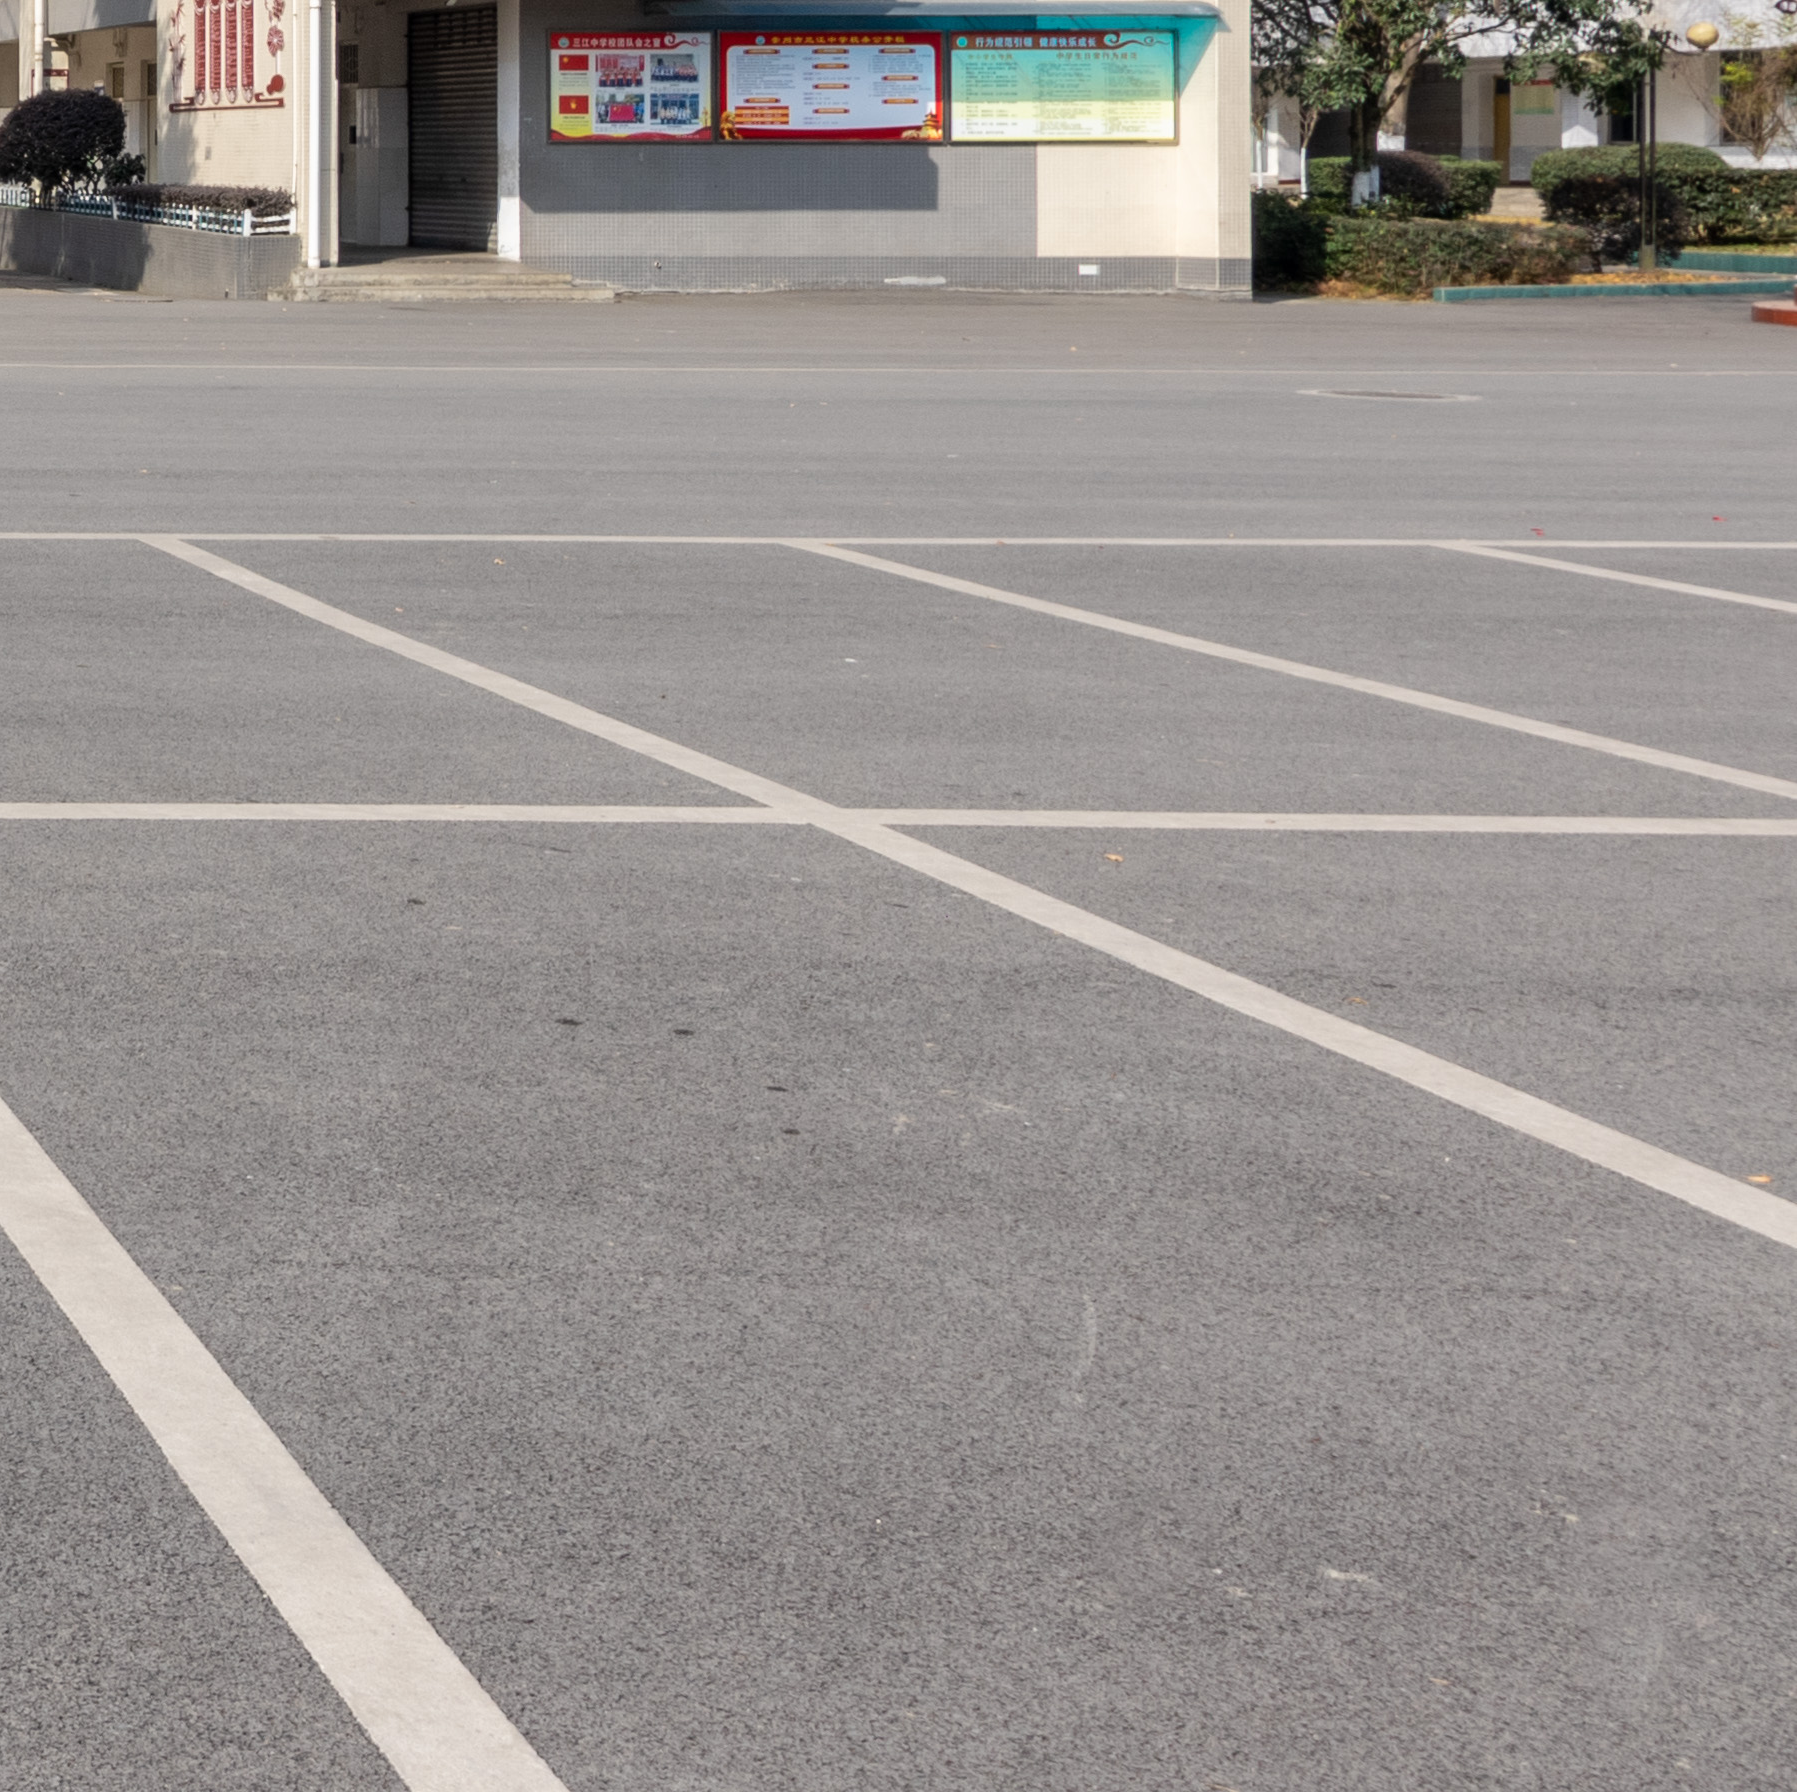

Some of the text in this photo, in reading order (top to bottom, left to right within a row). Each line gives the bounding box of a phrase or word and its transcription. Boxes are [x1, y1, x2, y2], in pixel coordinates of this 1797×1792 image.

[573, 37, 661, 48] 三江中学校团队会之窗
[771, 35, 905, 45] 崇州市三江中学校务公开栏
[975, 36, 1098, 48] 行为规范引领 健康快乐成长
